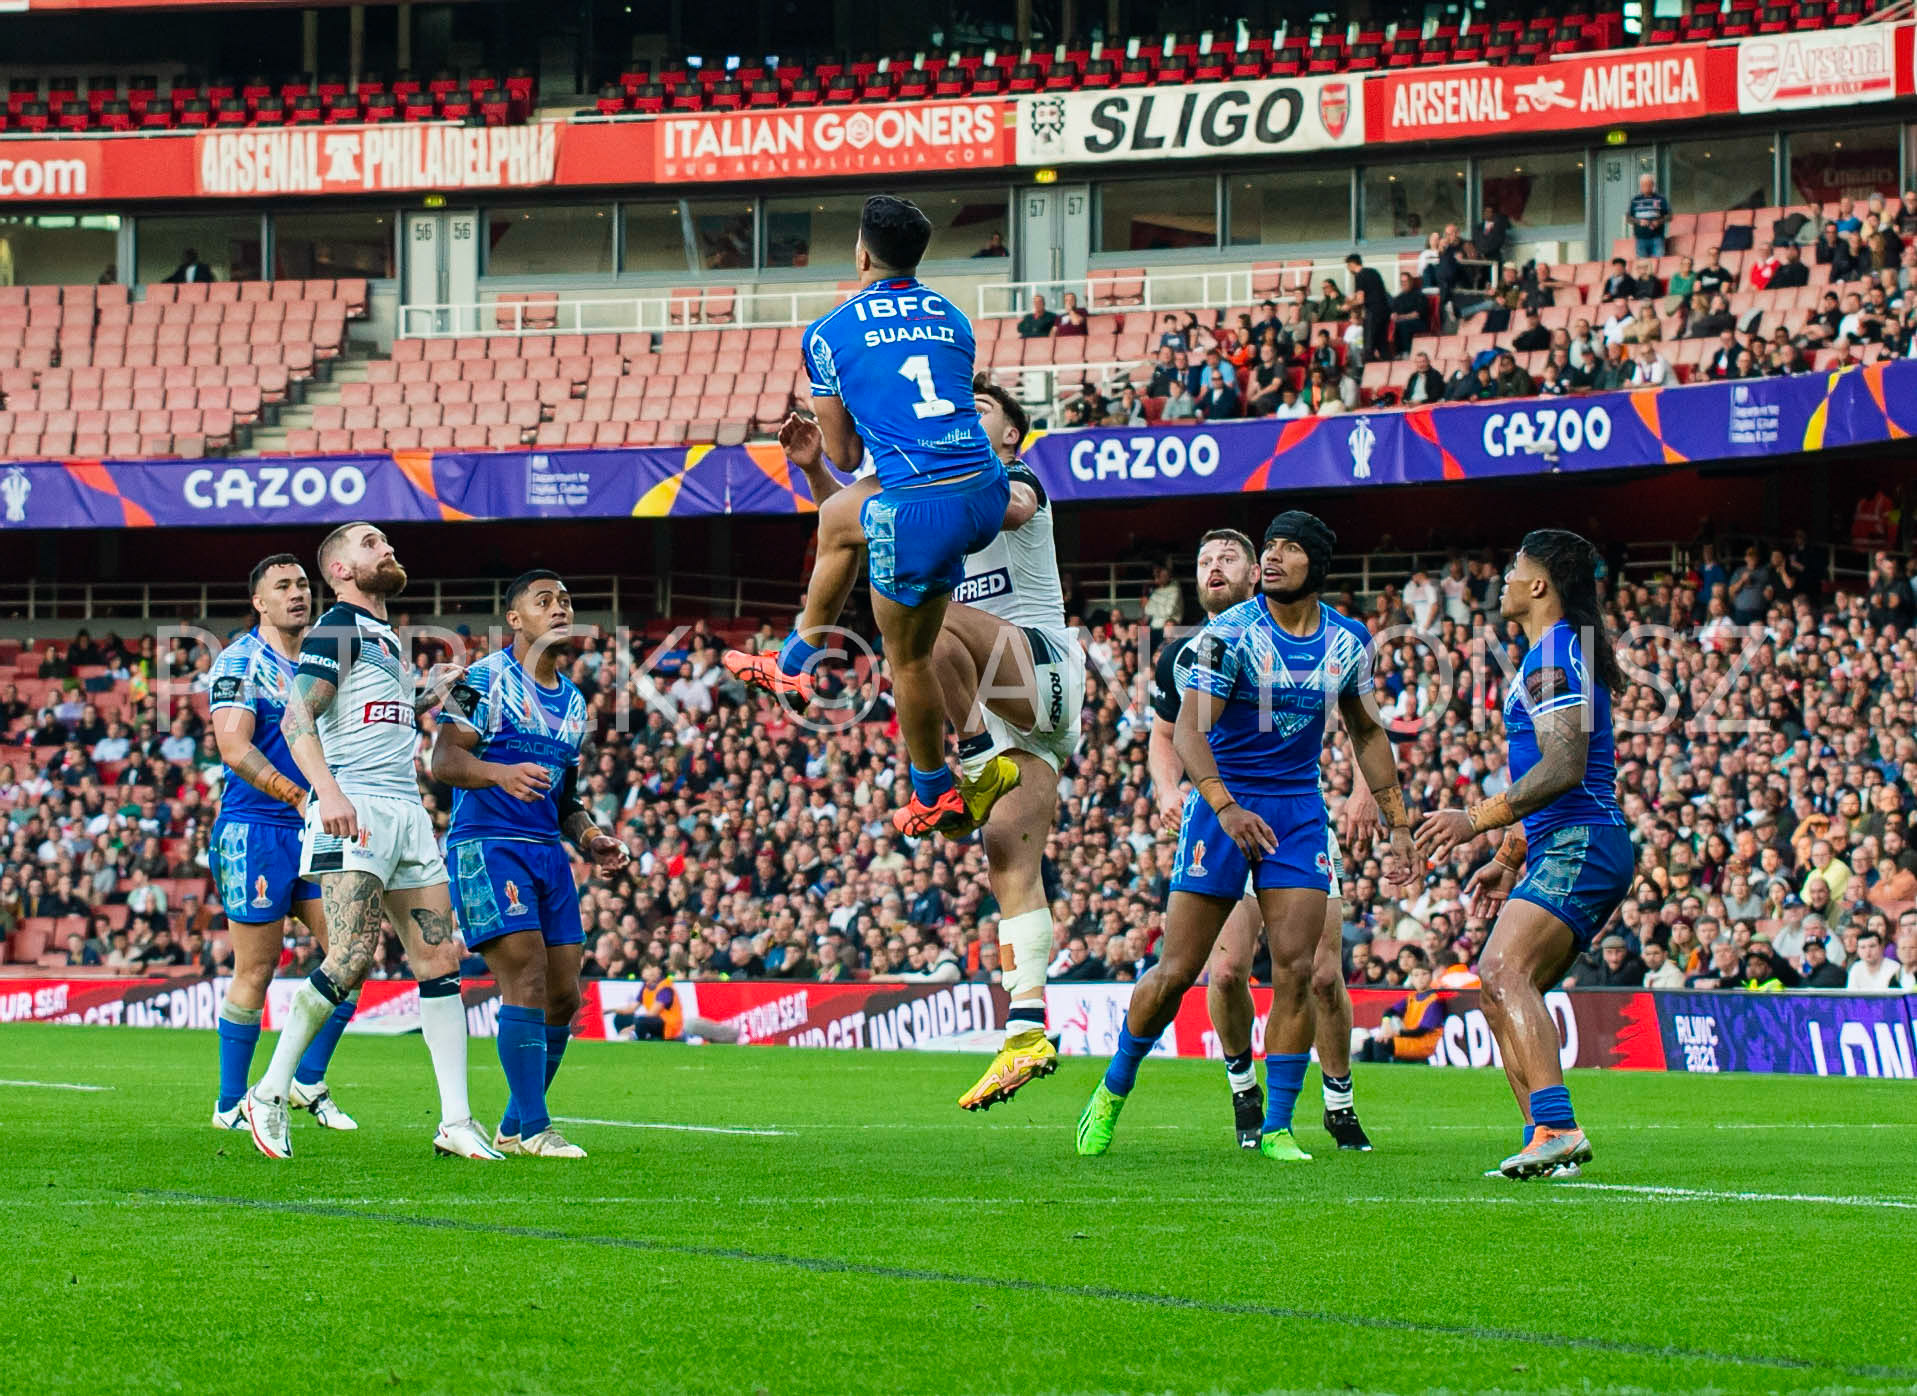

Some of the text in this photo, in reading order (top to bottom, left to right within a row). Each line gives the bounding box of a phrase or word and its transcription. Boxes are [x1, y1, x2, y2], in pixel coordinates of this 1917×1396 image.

[1392, 57, 1700, 127] ARSENAL AMERICA
[665, 104, 995, 158] ITALIAN GOONERS
[1084, 87, 1304, 153] SLIGO
[202, 124, 556, 192] ARSENAL PHILADELPHIA
[1029, 199, 1046, 218] 57
[1068, 196, 1083, 216] 57
[415, 222, 433, 241] 56
[453, 221, 471, 240] 56
[854, 295, 946, 322] IBFC
[897, 354, 956, 420] 1
[1483, 405, 1611, 458] CAZOO
[1069, 433, 1221, 482] CAZOO
[183, 465, 367, 509] CAZOO
[1684, 1046, 1719, 1072] 2021
